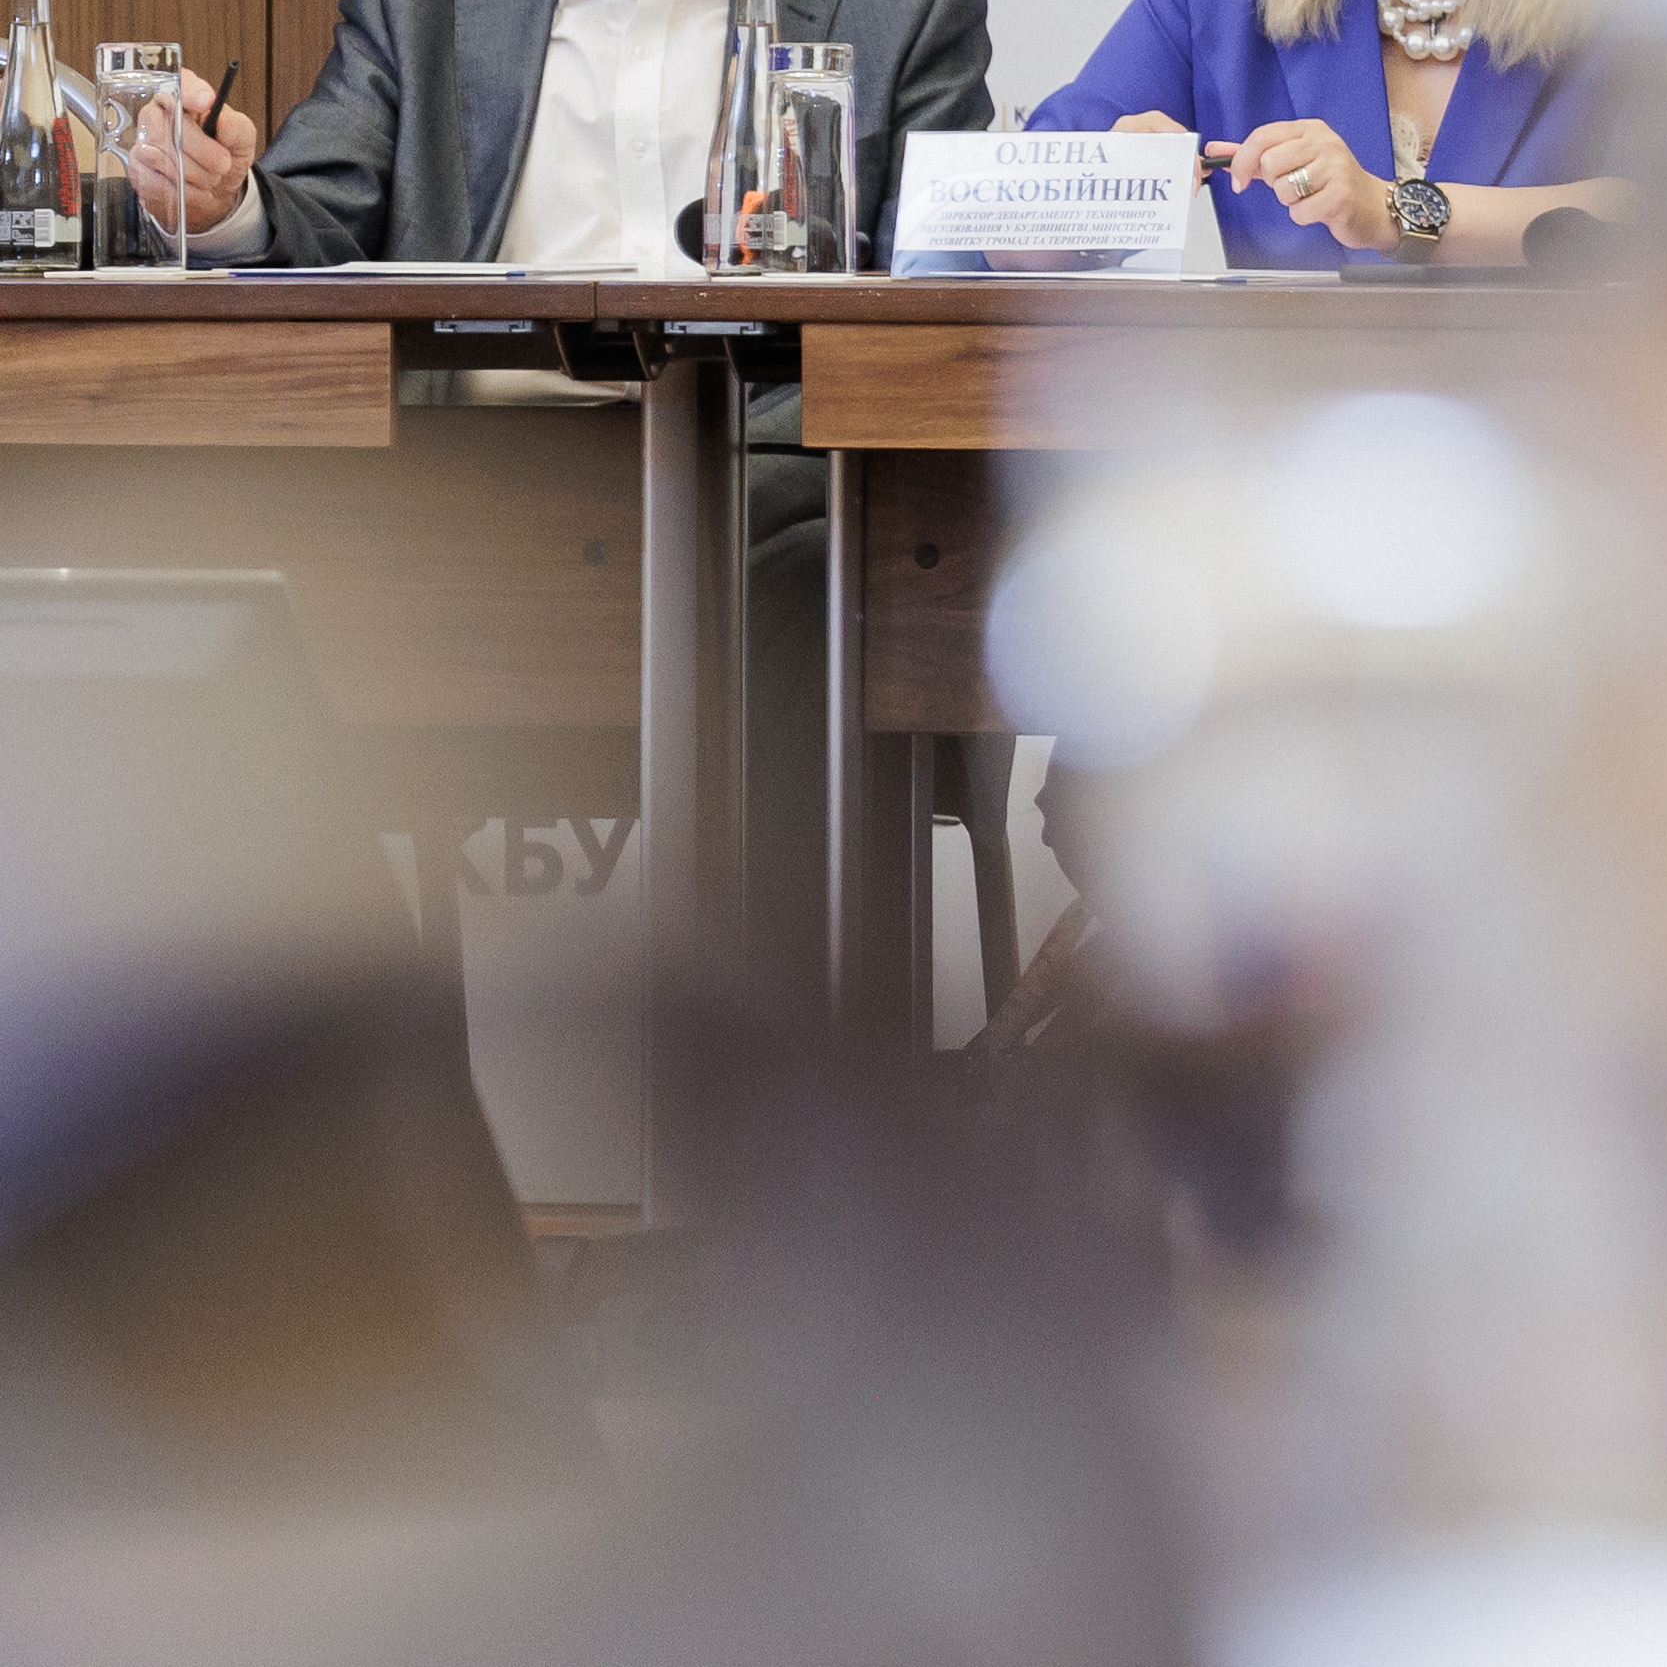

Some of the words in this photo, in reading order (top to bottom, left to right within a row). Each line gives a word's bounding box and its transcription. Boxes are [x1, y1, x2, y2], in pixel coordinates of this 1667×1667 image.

[995, 141, 1109, 164] ОЛЕНА
[929, 172, 1172, 203] ВОСКОБІЙНИК
[1085, 210, 1156, 220] ТЕХНІЧНОГО
[1091, 222, 1171, 232] МІНІСТЕРСТВА
